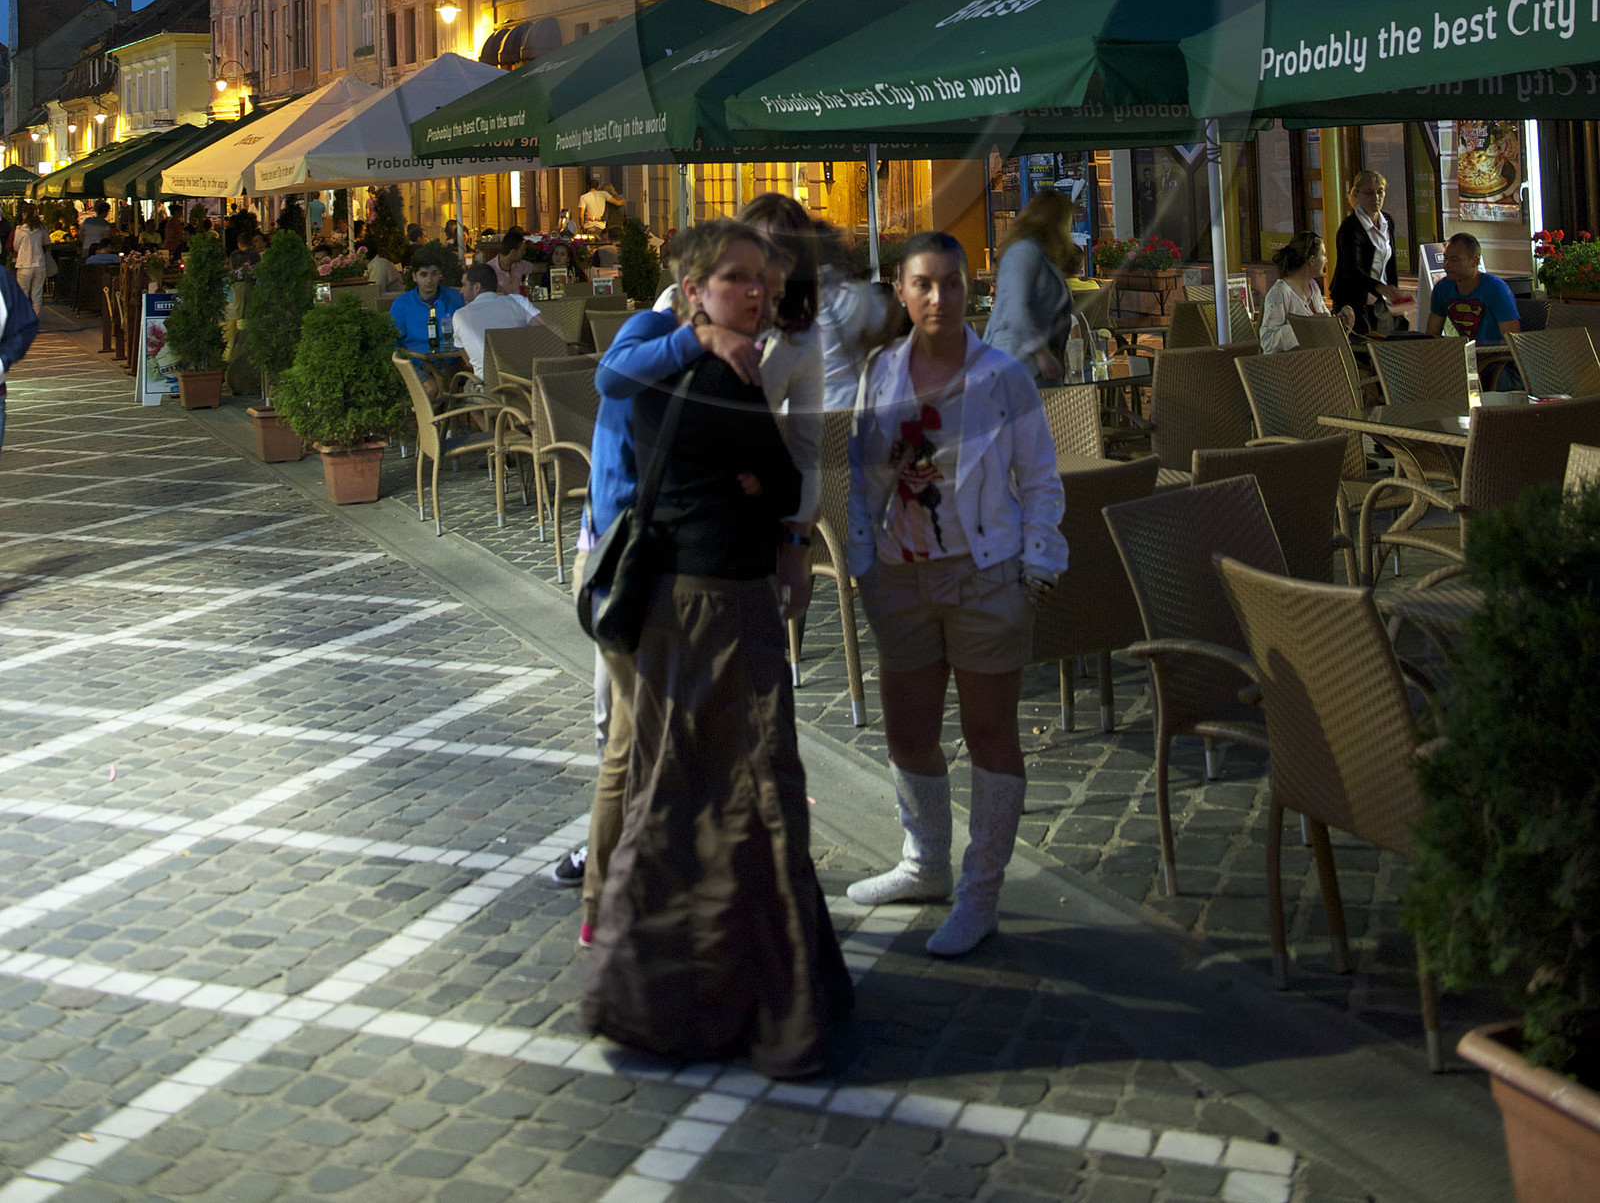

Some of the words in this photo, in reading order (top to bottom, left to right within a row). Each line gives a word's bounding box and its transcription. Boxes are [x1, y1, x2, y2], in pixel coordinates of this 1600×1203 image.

[1259, 32, 1368, 81] Probably
[1378, 21, 1421, 55] the
[1434, 5, 1497, 49] best
[761, 93, 821, 116] Probably
[819, 89, 847, 109] the
[839, 88, 881, 108] best
[874, 83, 915, 110] City
[910, 80, 934, 102] in
[933, 77, 966, 100] the
[967, 67, 1021, 97] world
[453, 122, 462, 137] the
[463, 120, 475, 134] best
[476, 117, 488, 134] City
[489, 115, 496, 130] in
[497, 113, 507, 129] the
[508, 110, 525, 127] world
[583, 127, 592, 145] the
[594, 124, 607, 142] best
[608, 120, 622, 143] City
[623, 118, 630, 137] in
[632, 116, 643, 136] the
[645, 112, 667, 134] world
